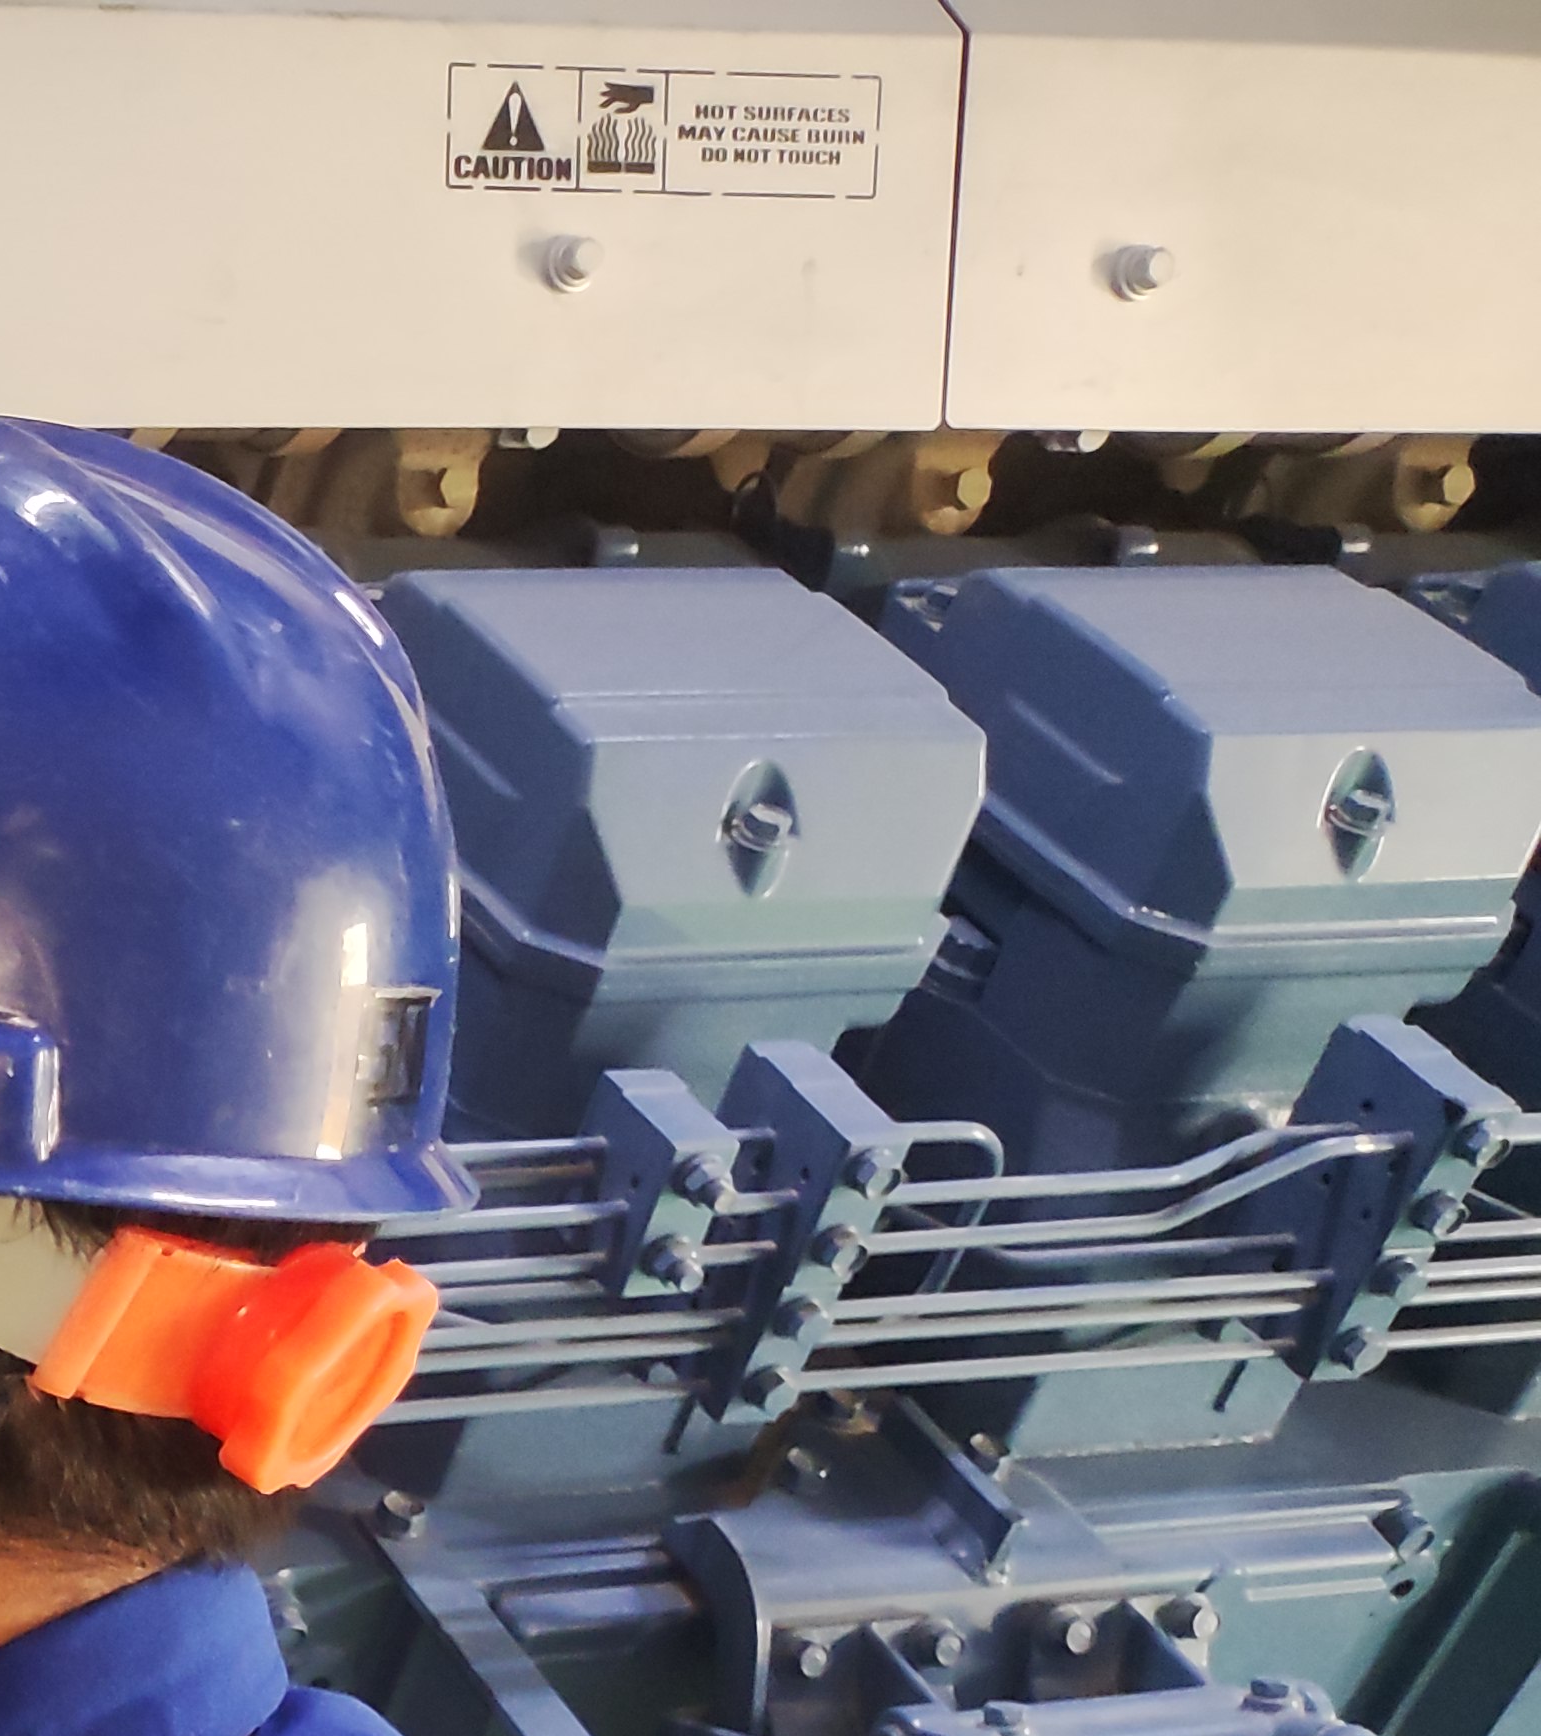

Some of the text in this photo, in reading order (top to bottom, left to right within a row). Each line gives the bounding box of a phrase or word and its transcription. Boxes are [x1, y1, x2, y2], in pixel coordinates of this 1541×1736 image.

[694, 103, 851, 124] HOT SURFACES
[677, 124, 866, 145] MAY CAUSE BURN
[701, 146, 842, 166] DO NOT TOUCH
[453, 154, 573, 182] CAUTION
